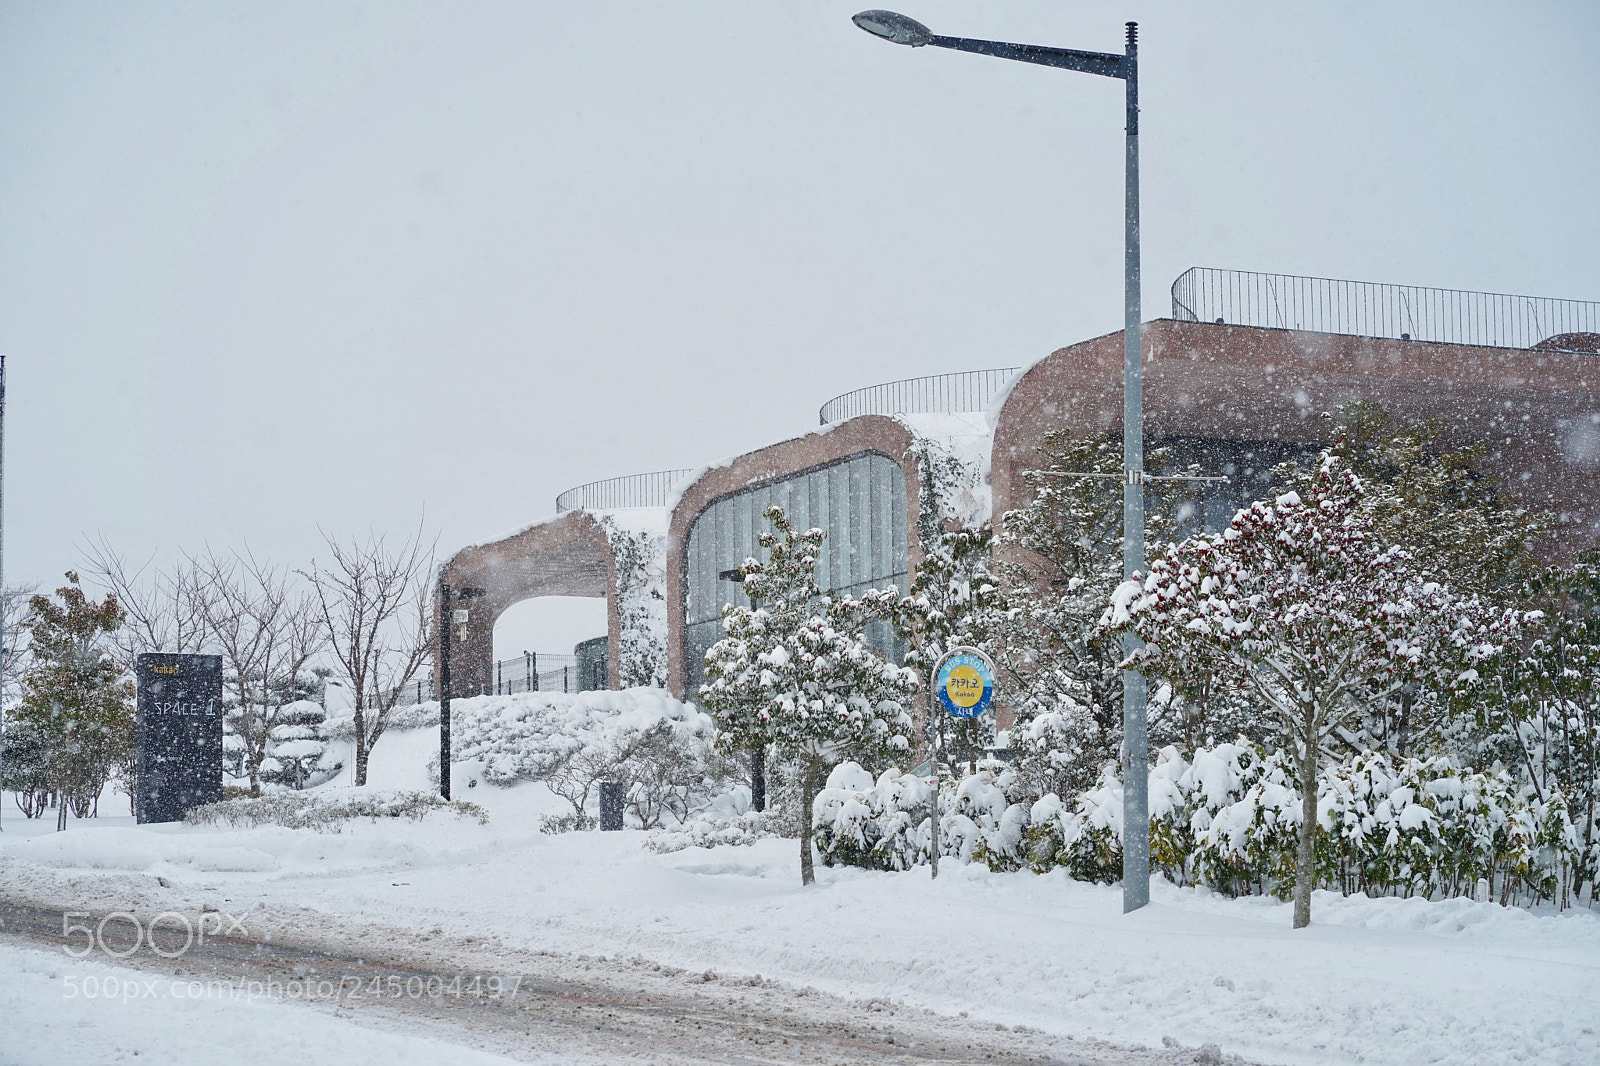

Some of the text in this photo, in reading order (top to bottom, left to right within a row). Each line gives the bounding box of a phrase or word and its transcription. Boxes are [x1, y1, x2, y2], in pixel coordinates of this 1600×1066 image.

[153, 664, 179, 674] kakao
[963, 656, 985, 672] STOP
[951, 678, 979, 689] 카카오
[154, 698, 216, 716] SPACE 1
